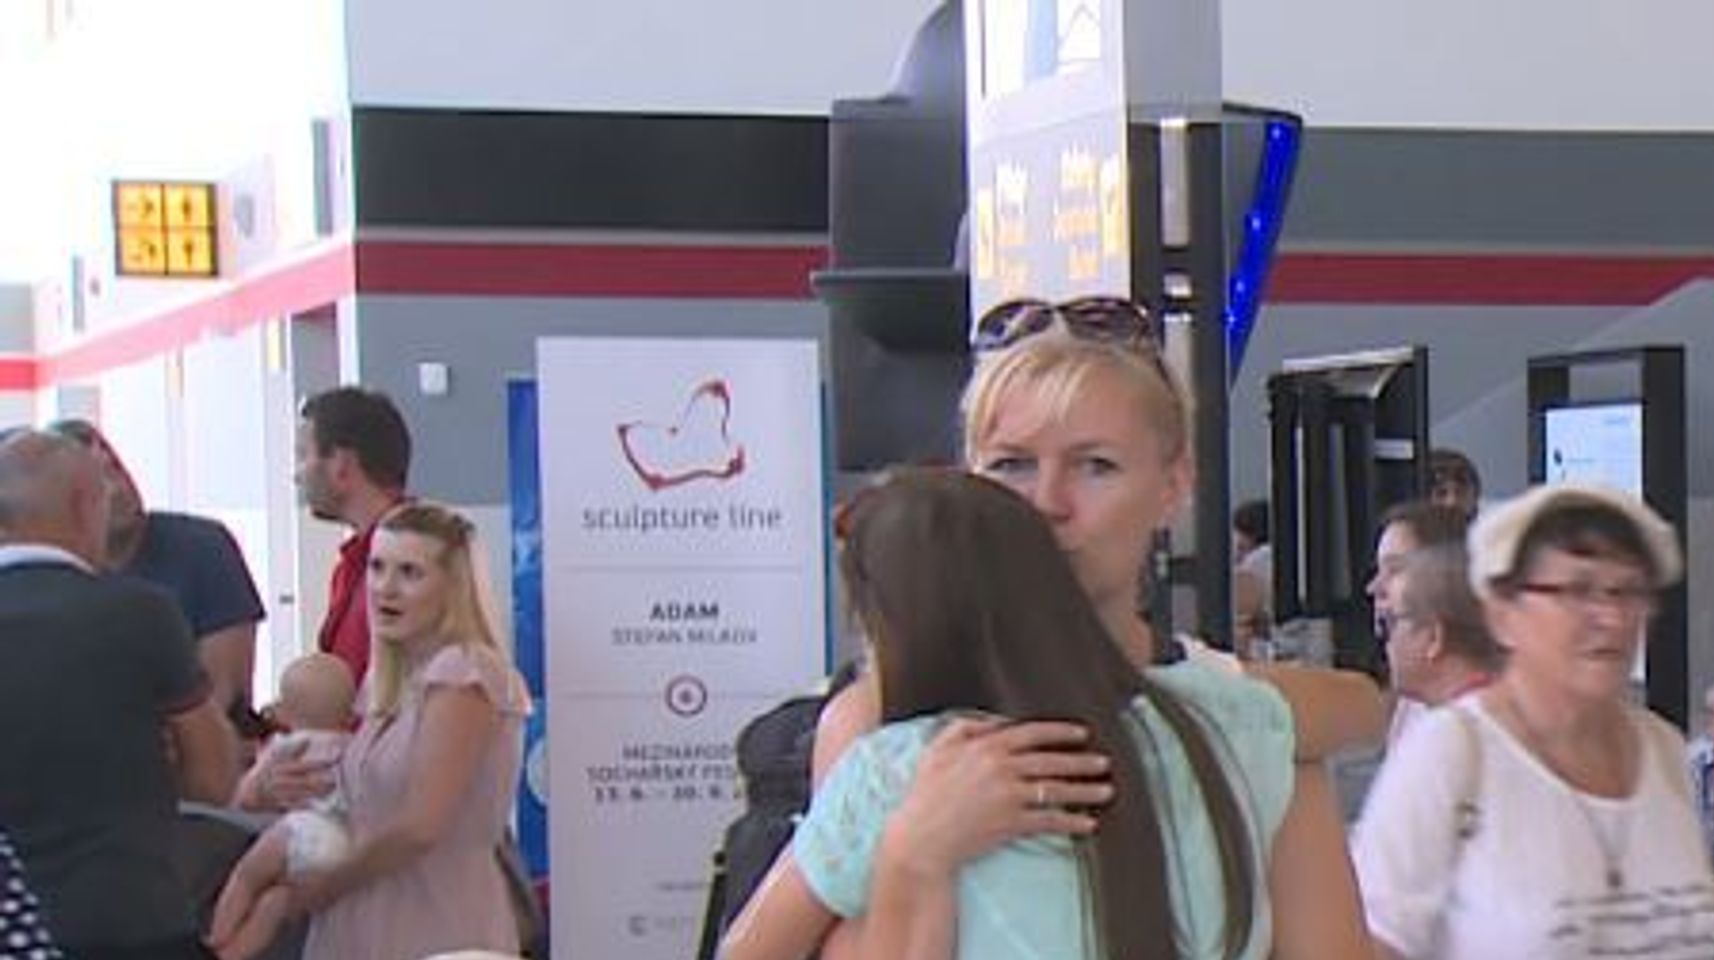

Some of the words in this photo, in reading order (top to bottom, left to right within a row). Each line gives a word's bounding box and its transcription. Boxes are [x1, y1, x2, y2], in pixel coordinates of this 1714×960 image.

[582, 503, 719, 531] sculpture
[728, 503, 782, 529] line
[650, 603, 719, 621] ADAM
